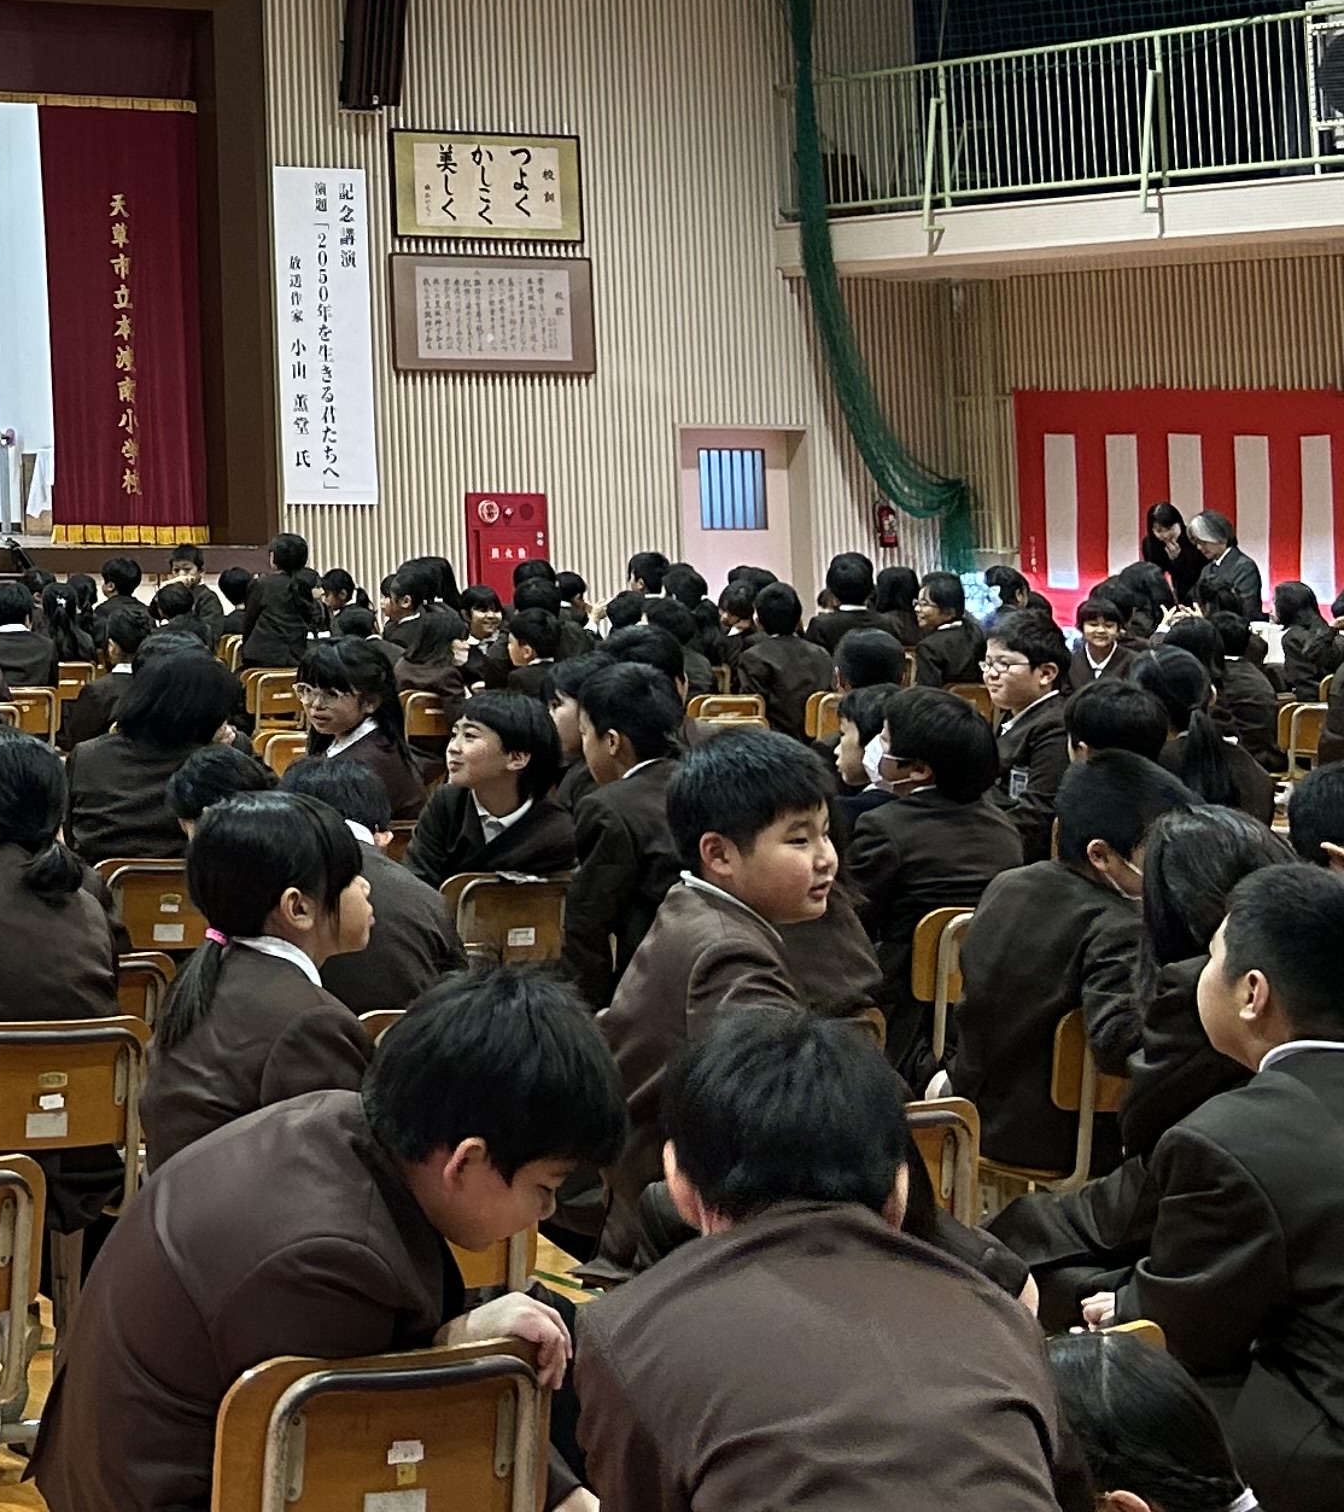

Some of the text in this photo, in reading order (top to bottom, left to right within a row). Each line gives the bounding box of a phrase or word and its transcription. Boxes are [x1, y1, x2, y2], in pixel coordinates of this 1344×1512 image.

[314, 181, 328, 212] 演題
[436, 144, 458, 221] 美しく
[471, 144, 494, 225] かしこく
[510, 148, 532, 217] つよく
[338, 182, 357, 268] 記念講演
[289, 255, 304, 323] 放送作家
[110, 193, 143, 497] 天草市立本渡南小学校
[291, 338, 307, 379] 小山
[295, 449, 311, 468] 氏
